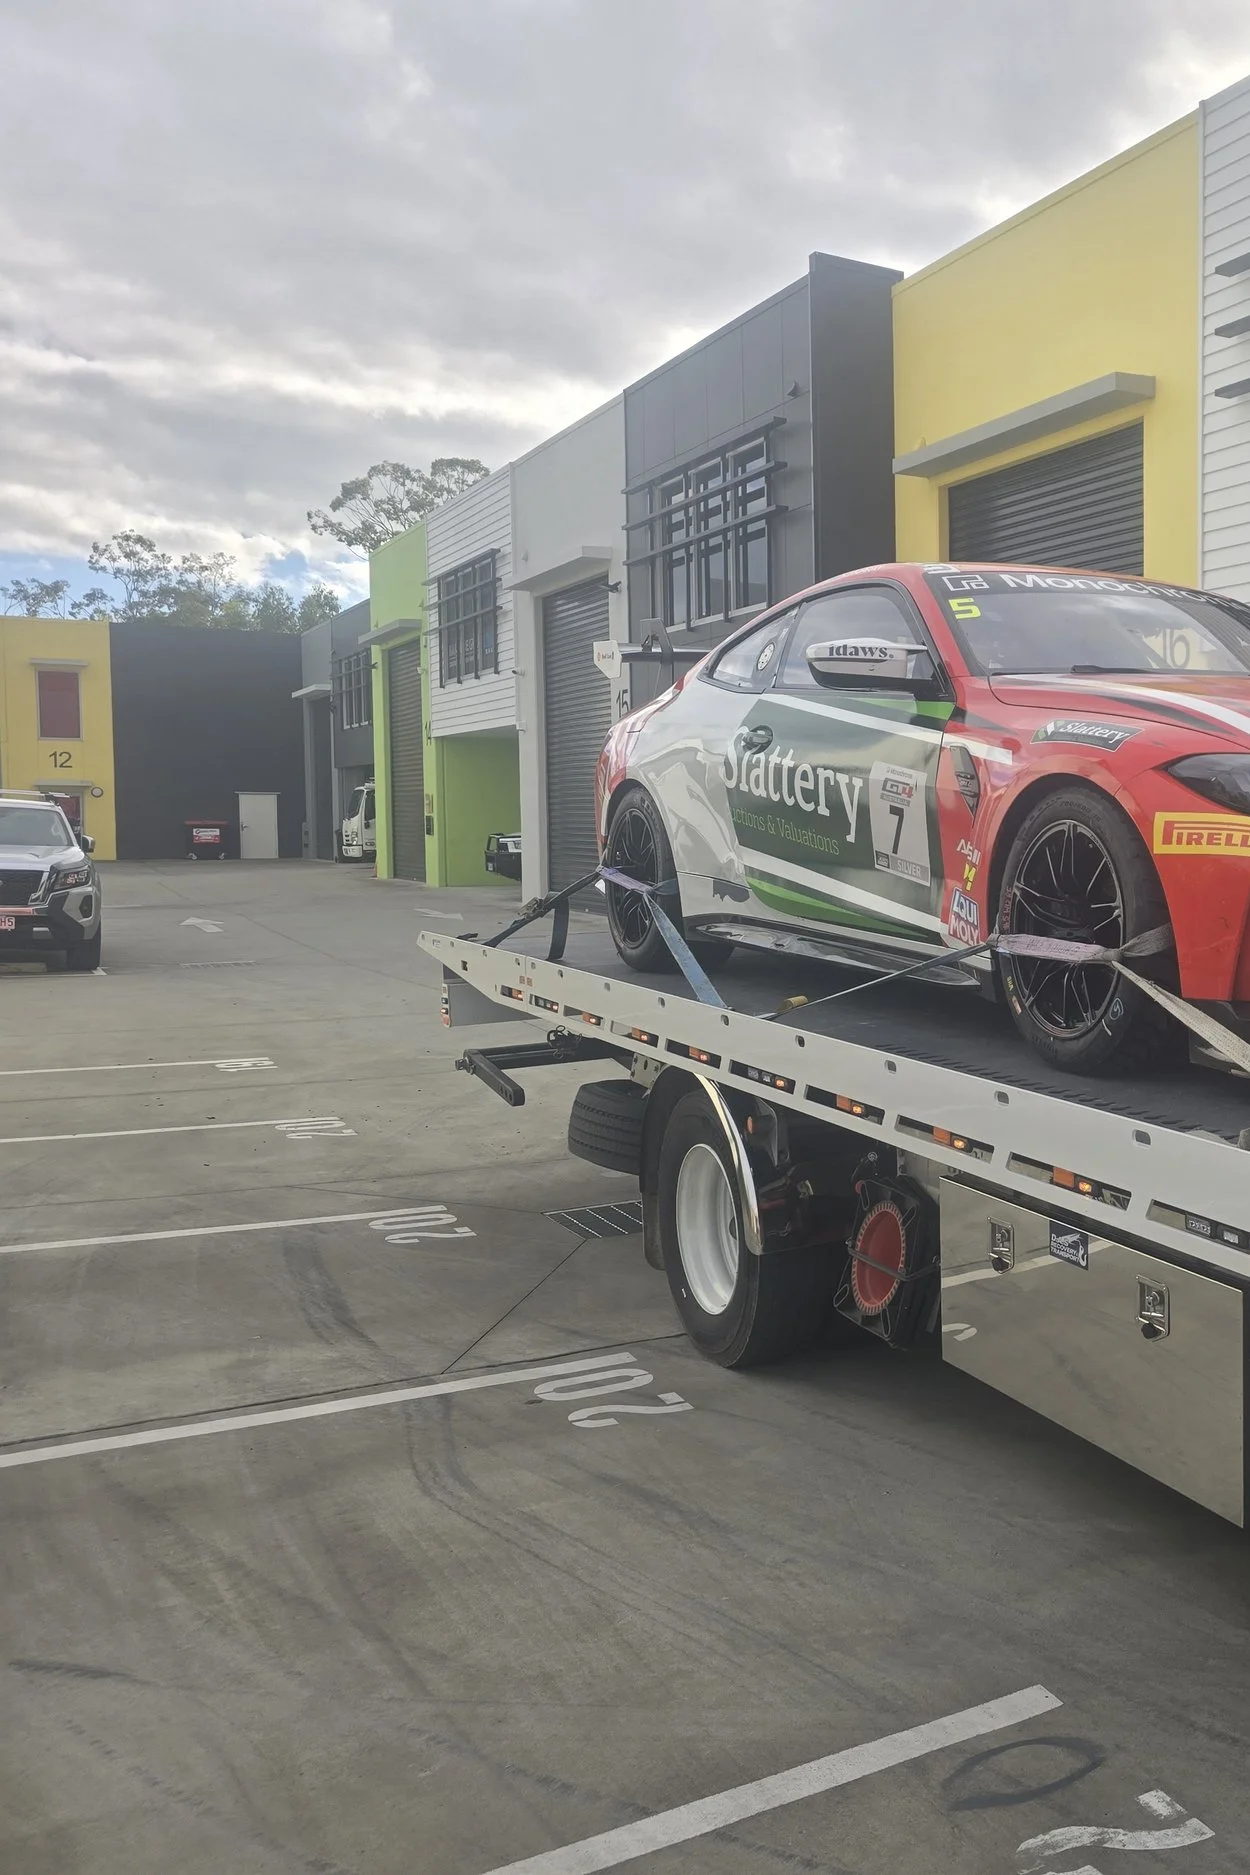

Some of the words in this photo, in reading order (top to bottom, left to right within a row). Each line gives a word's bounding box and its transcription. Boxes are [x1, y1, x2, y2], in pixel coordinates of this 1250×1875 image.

[949, 597, 981, 620] 5
[1060, 721, 1131, 744] Slattery
[49, 751, 73, 768] 12
[719, 725, 864, 844] Slattery
[731, 806, 767, 833] uctions
[767, 814, 777, 836] &
[776, 817, 841, 857] Valuations
[889, 804, 905, 855] 7
[896, 859, 923, 878] SILVER
[949, 914, 979, 947] MOLY
[368, 1211, 478, 1244] 20
[532, 1367, 695, 1429] 20
